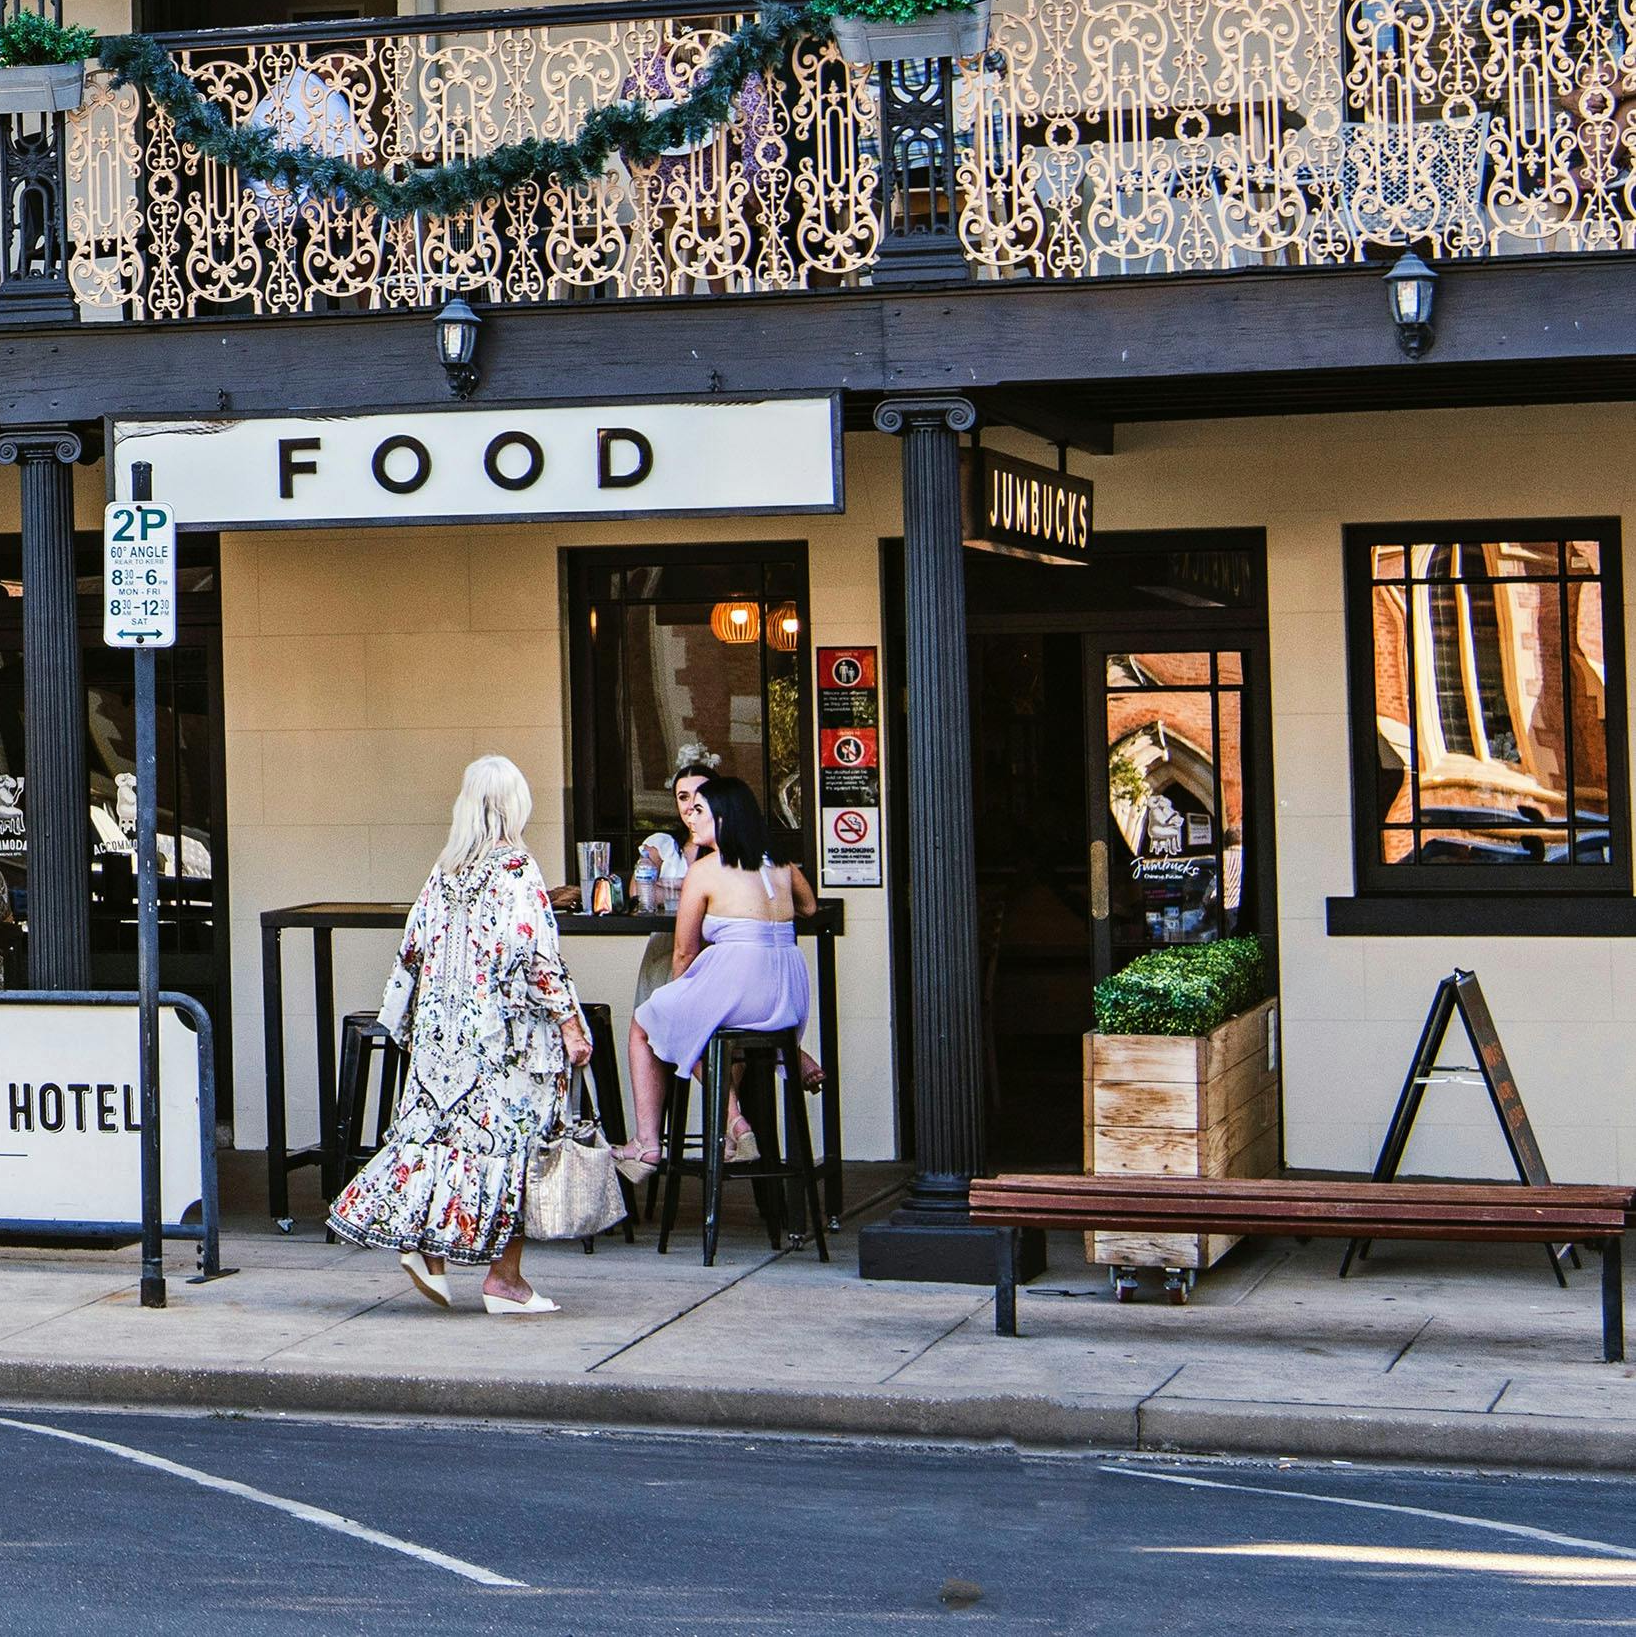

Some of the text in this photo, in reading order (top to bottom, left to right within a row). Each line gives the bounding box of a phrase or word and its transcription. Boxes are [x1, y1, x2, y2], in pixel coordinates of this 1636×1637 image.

[278, 427, 654, 498] FOOD
[112, 509, 167, 542] 2P
[990, 469, 1087, 549] JUMBUCKS
[111, 546, 168, 558] 60° ANGLE
[1130, 854, 1200, 879] Jumbucks
[8, 1082, 142, 1134] HOTEL
